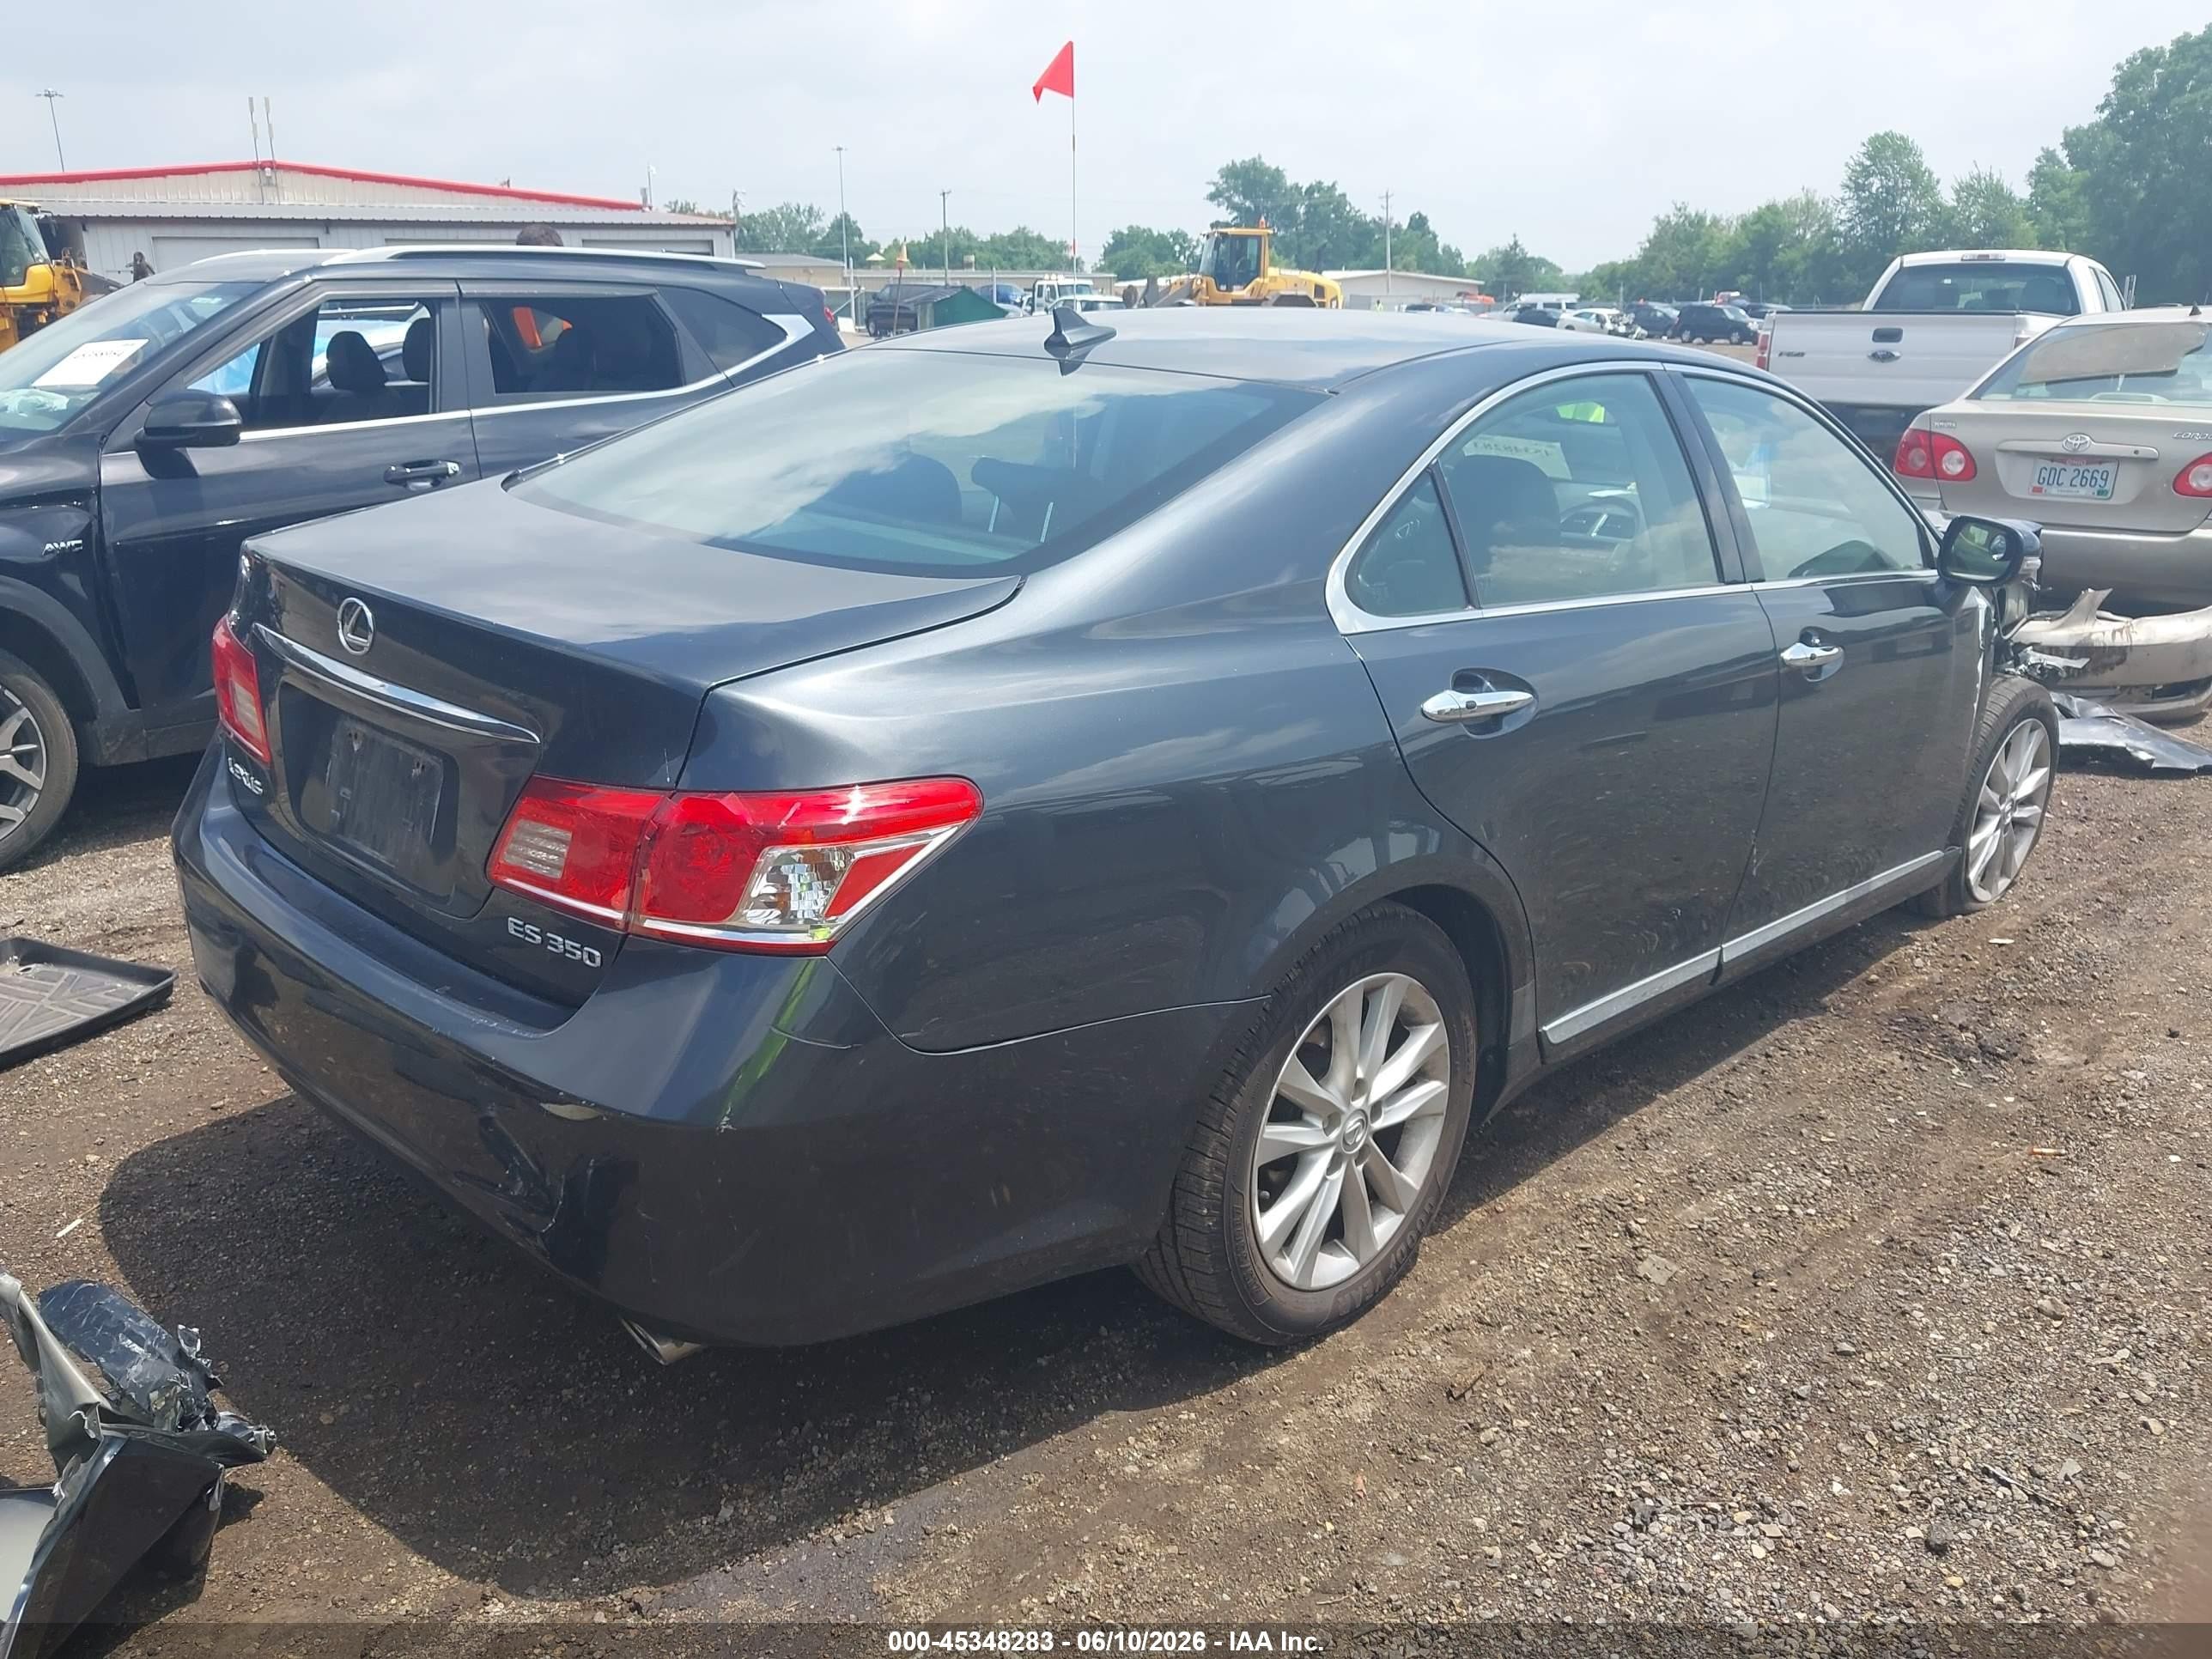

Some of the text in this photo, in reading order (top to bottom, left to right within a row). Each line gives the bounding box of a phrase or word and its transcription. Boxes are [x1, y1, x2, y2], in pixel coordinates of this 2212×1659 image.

[2038, 466, 2109, 489] GDC 2669
[228, 757, 264, 796] LEXUS
[507, 916, 602, 969] ES 350
